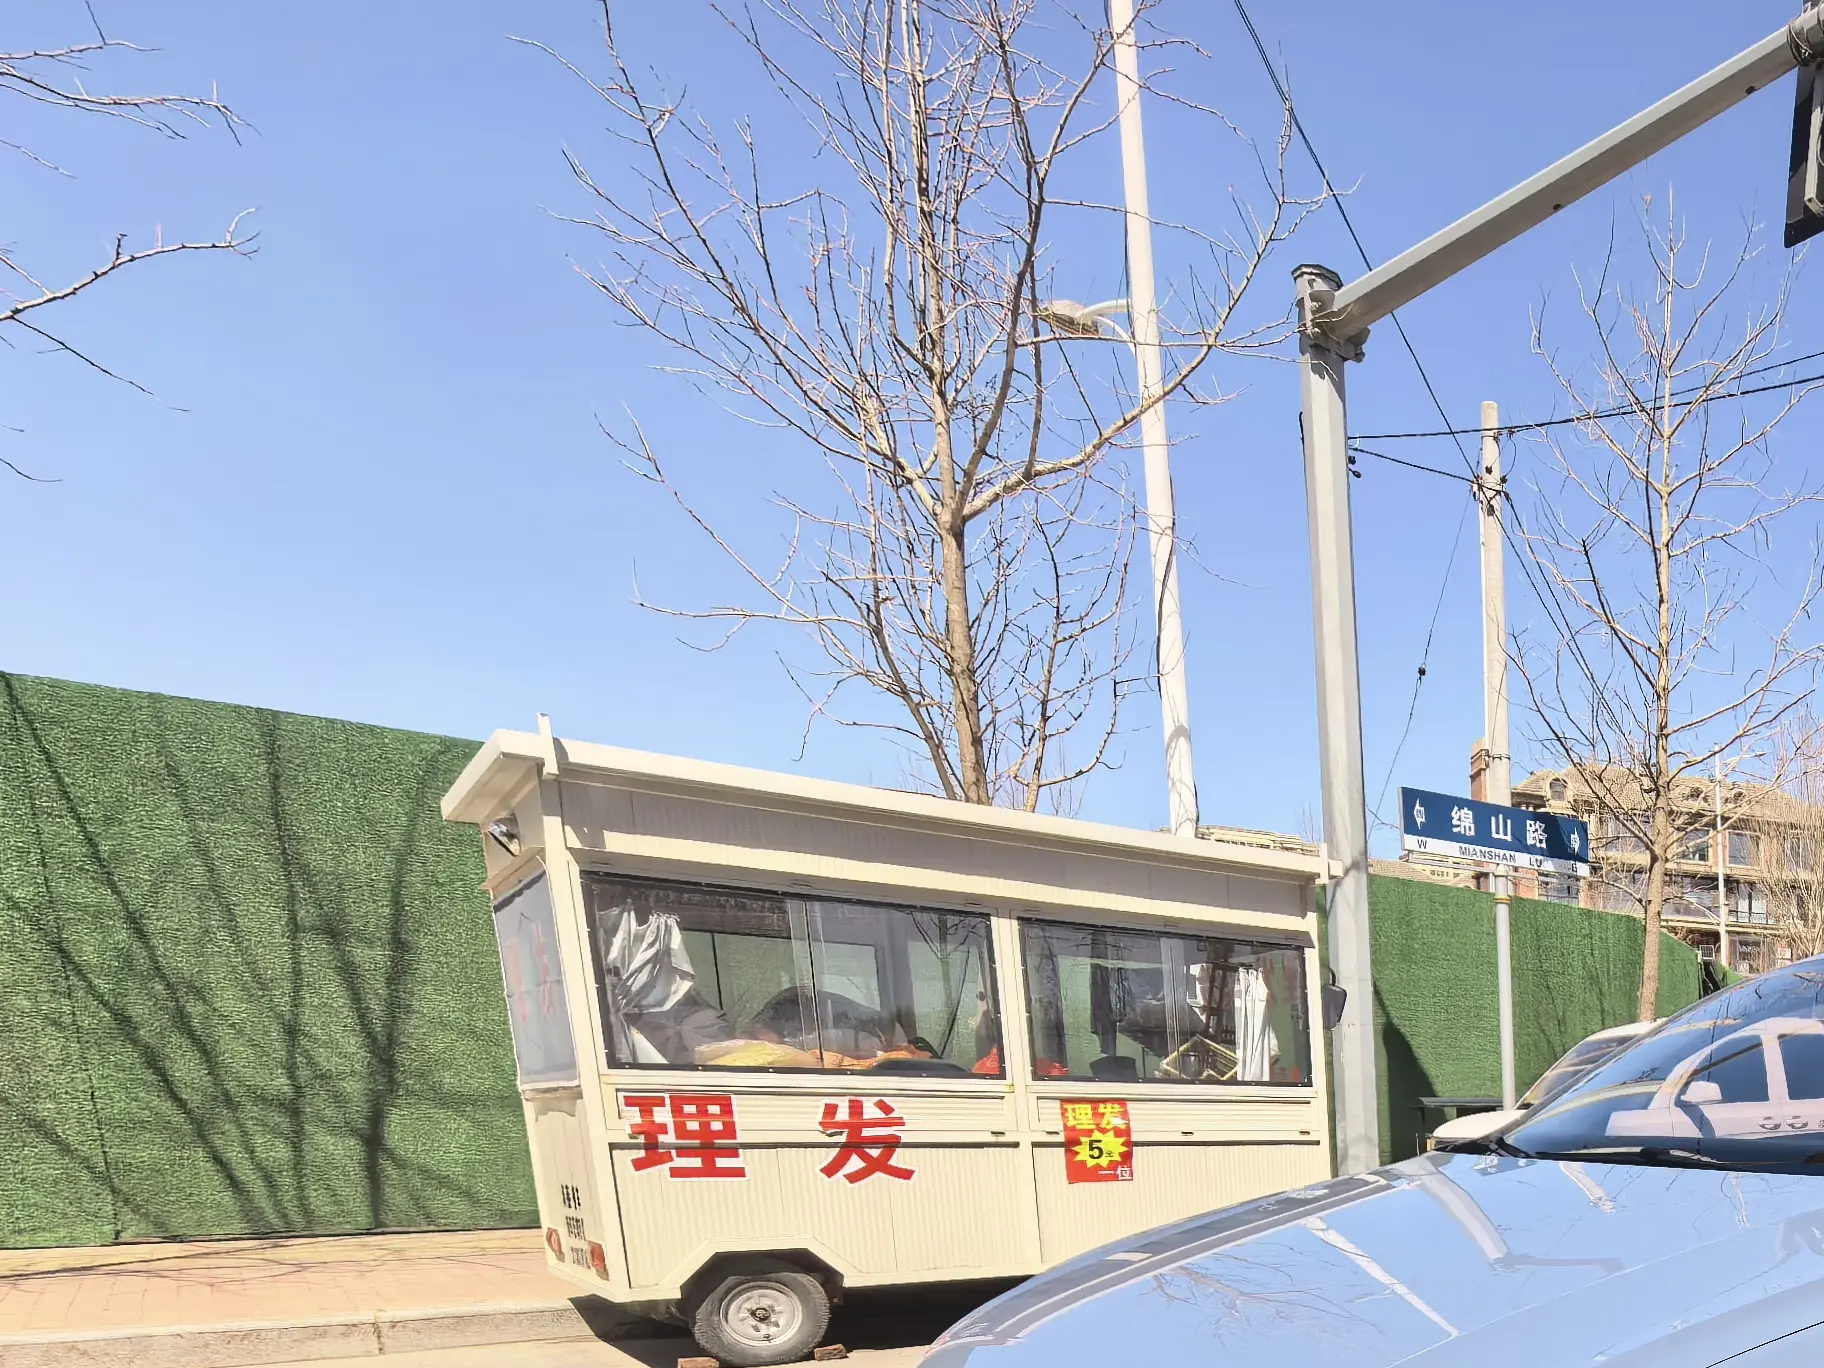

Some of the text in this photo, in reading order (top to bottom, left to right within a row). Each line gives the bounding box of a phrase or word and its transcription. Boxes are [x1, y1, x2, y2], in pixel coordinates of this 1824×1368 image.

[1451, 804, 1548, 849] 绵山路
[1417, 838, 1427, 849] W
[1458, 845, 1516, 864] MIANSHAN
[1063, 1102, 1130, 1130] 理发
[622, 1092, 917, 1184] 理发
[1098, 1164, 1132, 1180] 一位
